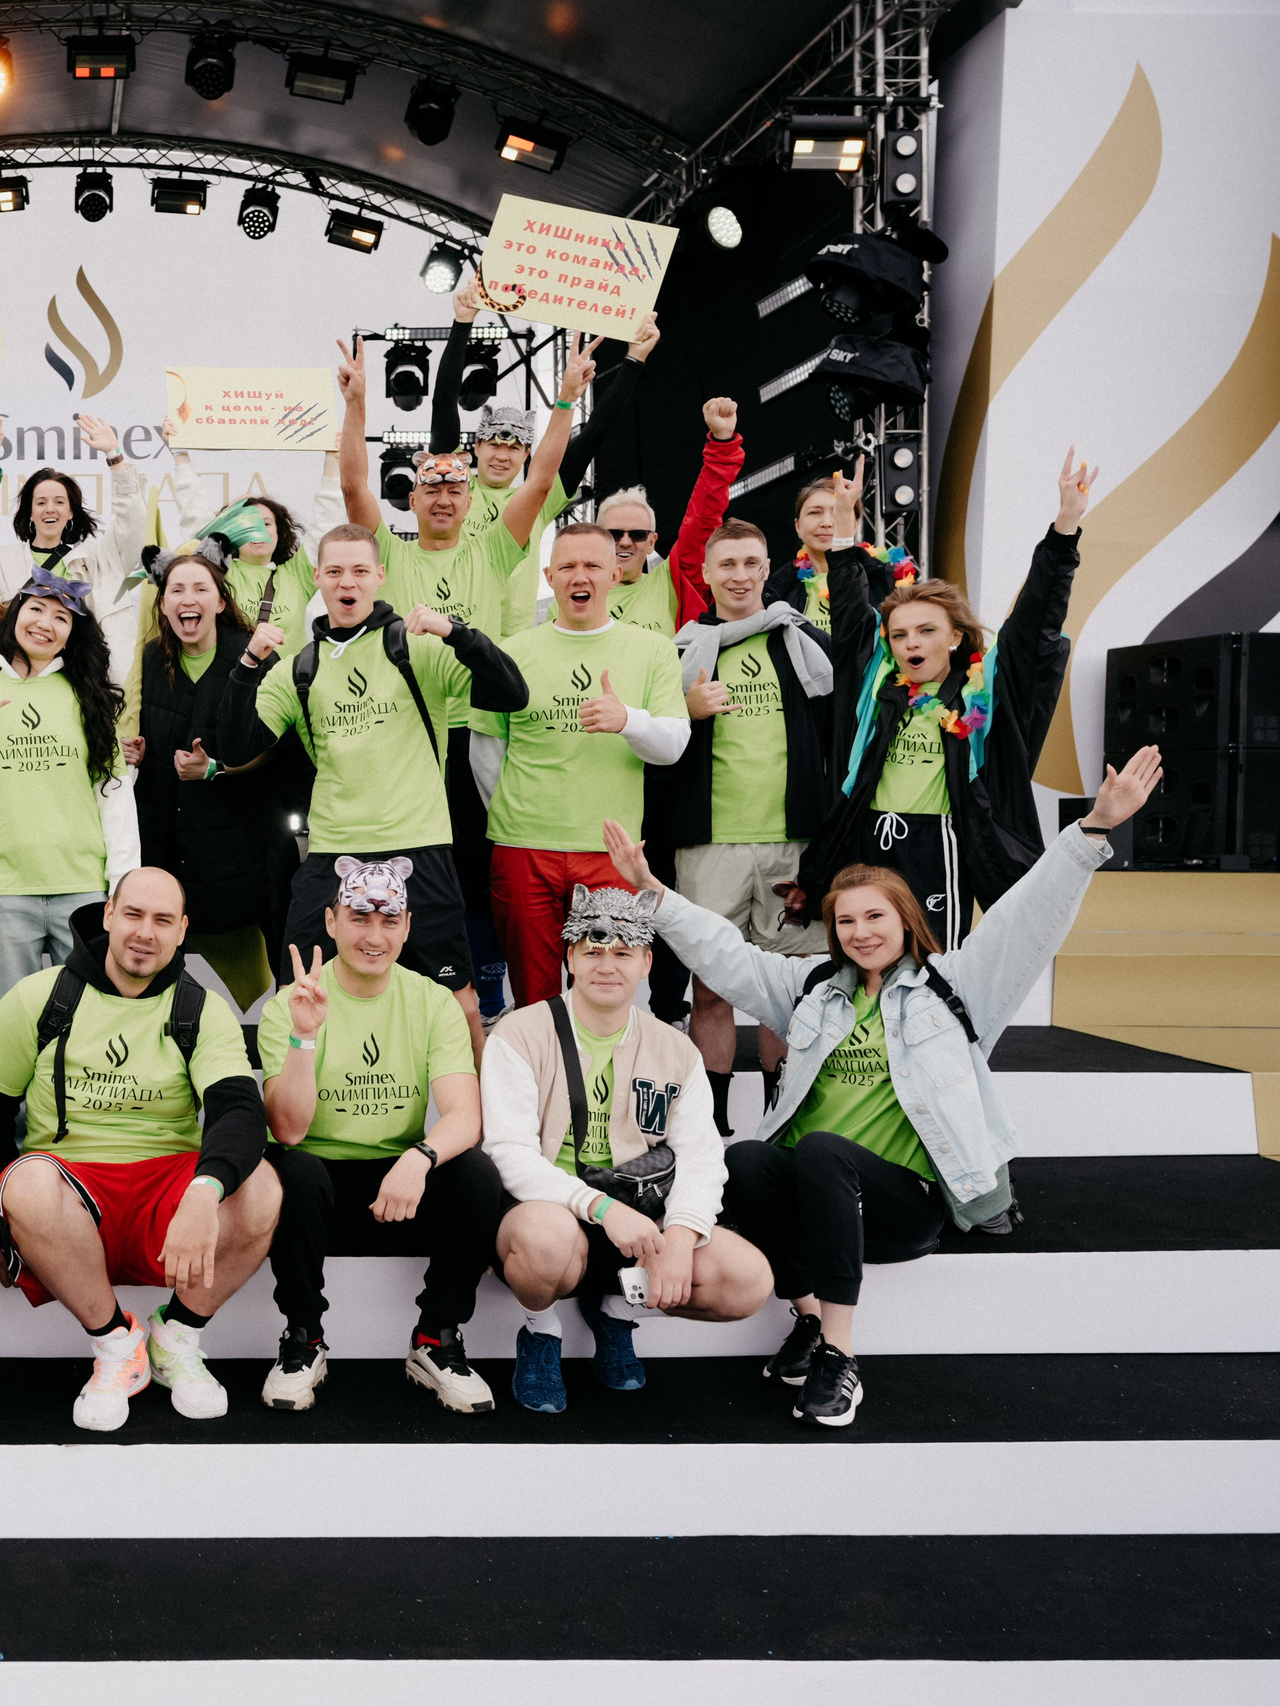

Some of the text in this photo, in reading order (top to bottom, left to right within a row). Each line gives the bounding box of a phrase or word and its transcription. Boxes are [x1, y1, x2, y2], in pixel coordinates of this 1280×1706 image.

[523, 219, 626, 251] ХИШники
[503, 239, 647, 280] это команда,
[514, 264, 621, 297] это прайд
[222, 390, 285, 400] ХИШуй
[204, 404, 214, 412] к
[221, 404, 263, 413] цели
[195, 416, 269, 425] сбавляй
[426, 602, 465, 615] minex
[725, 681, 778, 694] Sminex
[334, 694, 375, 713] Sminex
[737, 705, 770, 717] 2025
[341, 721, 370, 737] 2025
[561, 722, 587, 733] 202
[6, 733, 58, 746] Sminex
[17, 760, 50, 772] 2025
[828, 1046, 882, 1058] minex
[81, 1066, 139, 1085] Sminex
[345, 1071, 396, 1086] Sminex
[841, 1071, 875, 1087] 2025
[317, 1085, 421, 1102] ОЛИМПИАДА
[82, 1096, 124, 1112] 2025
[352, 1103, 389, 1116] 2025
[632, 1077, 681, 1136] W
